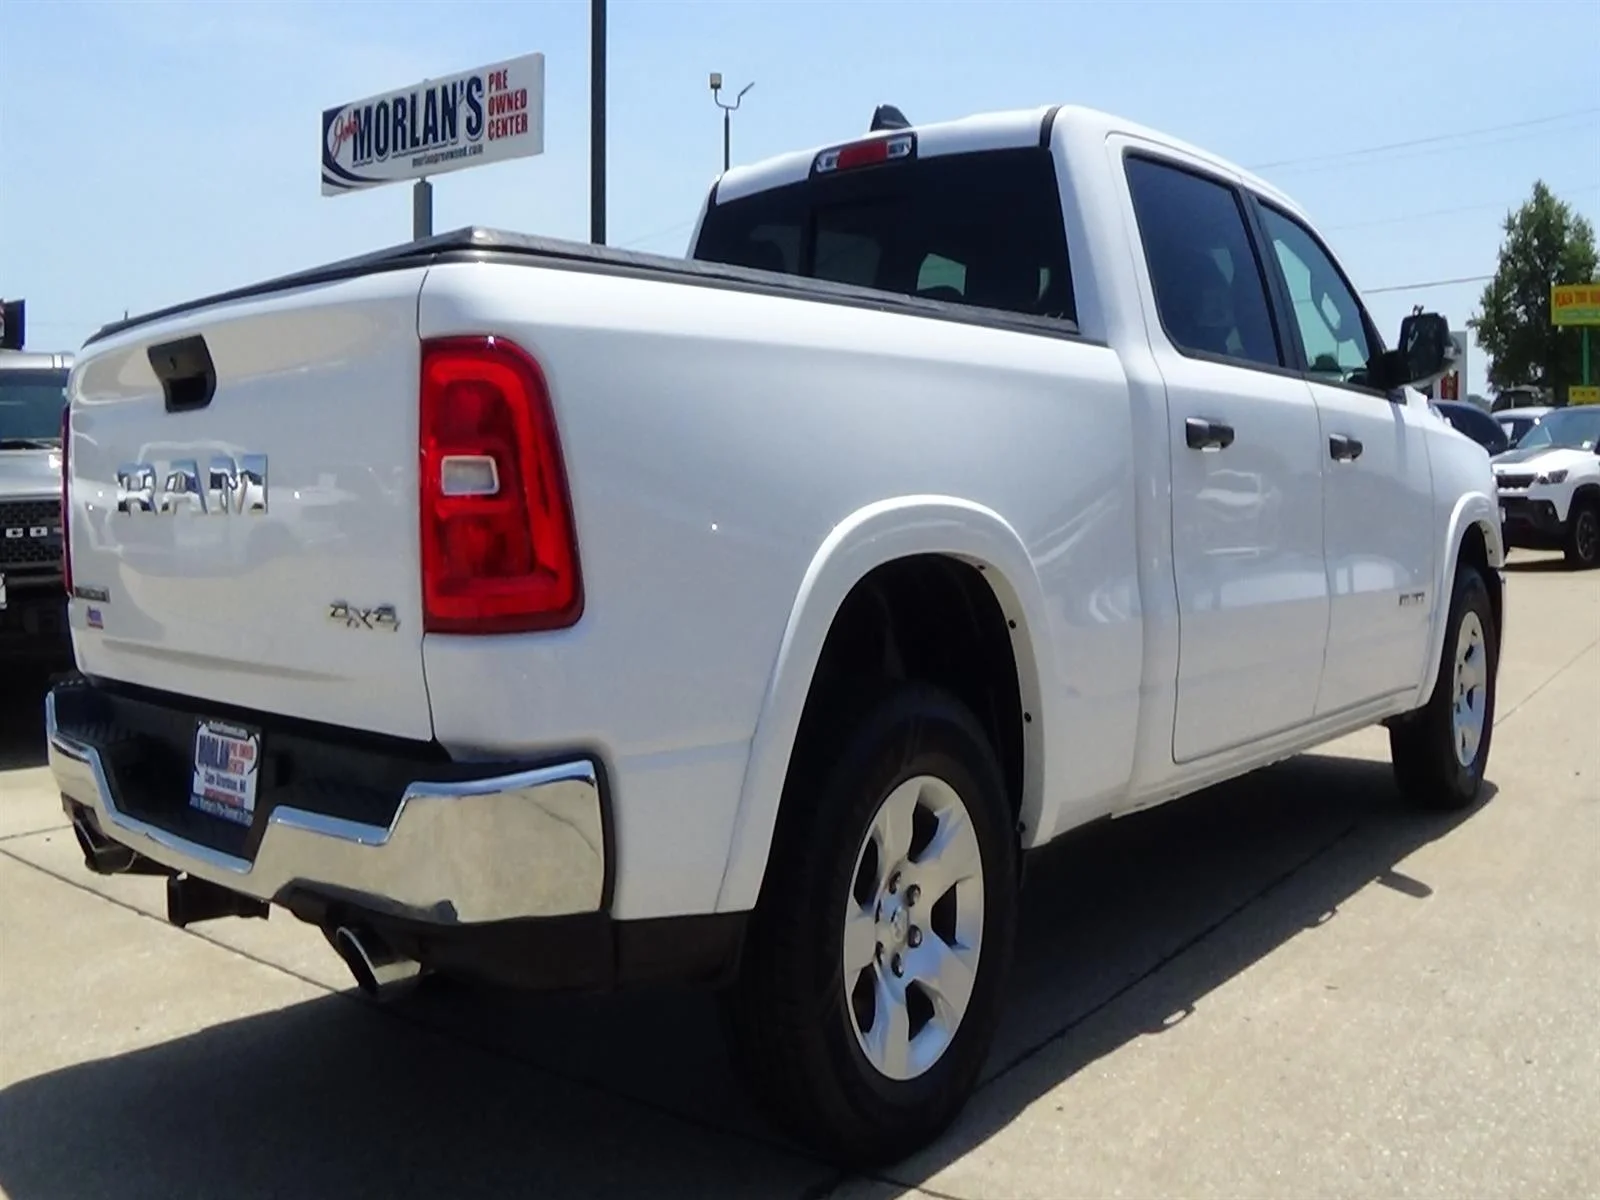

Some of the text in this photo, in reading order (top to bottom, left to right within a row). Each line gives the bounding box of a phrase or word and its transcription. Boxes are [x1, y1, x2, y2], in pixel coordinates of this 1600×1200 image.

[488, 69, 509, 93] PRE
[488, 88, 528, 116] OWNED
[352, 76, 484, 164] MORLAN'S
[488, 113, 528, 141] CENTER
[116, 454, 268, 515] RAM
